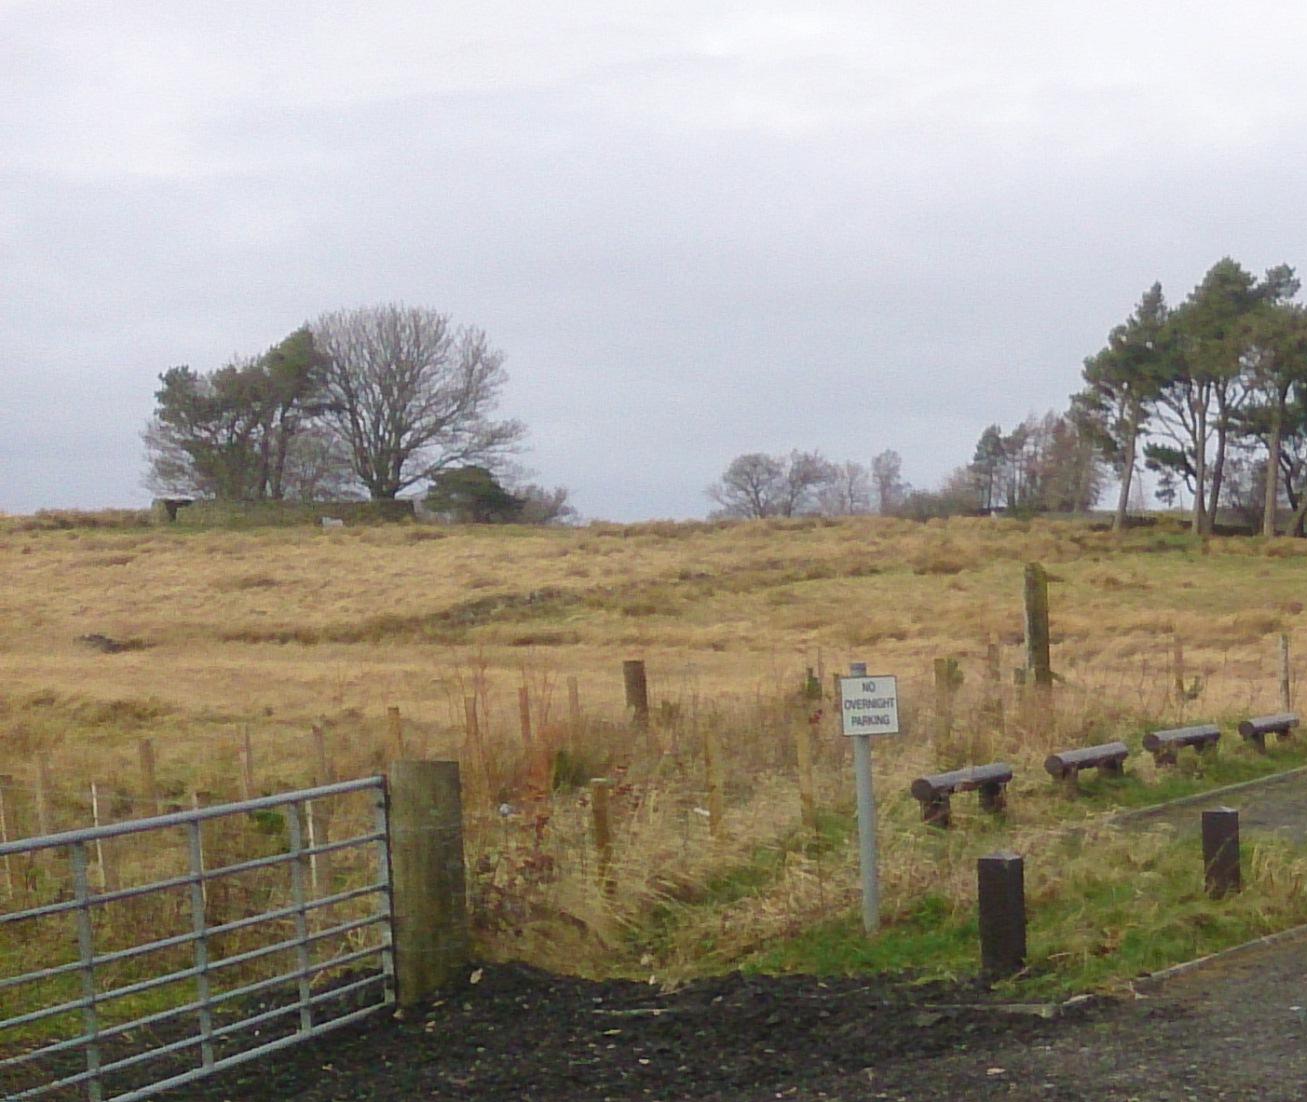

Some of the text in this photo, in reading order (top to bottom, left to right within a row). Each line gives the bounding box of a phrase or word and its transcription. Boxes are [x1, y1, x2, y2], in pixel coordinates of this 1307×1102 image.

[862, 681, 876, 693] NO
[844, 698, 895, 710] OVERNIGHT
[851, 715, 890, 726] PARKING
